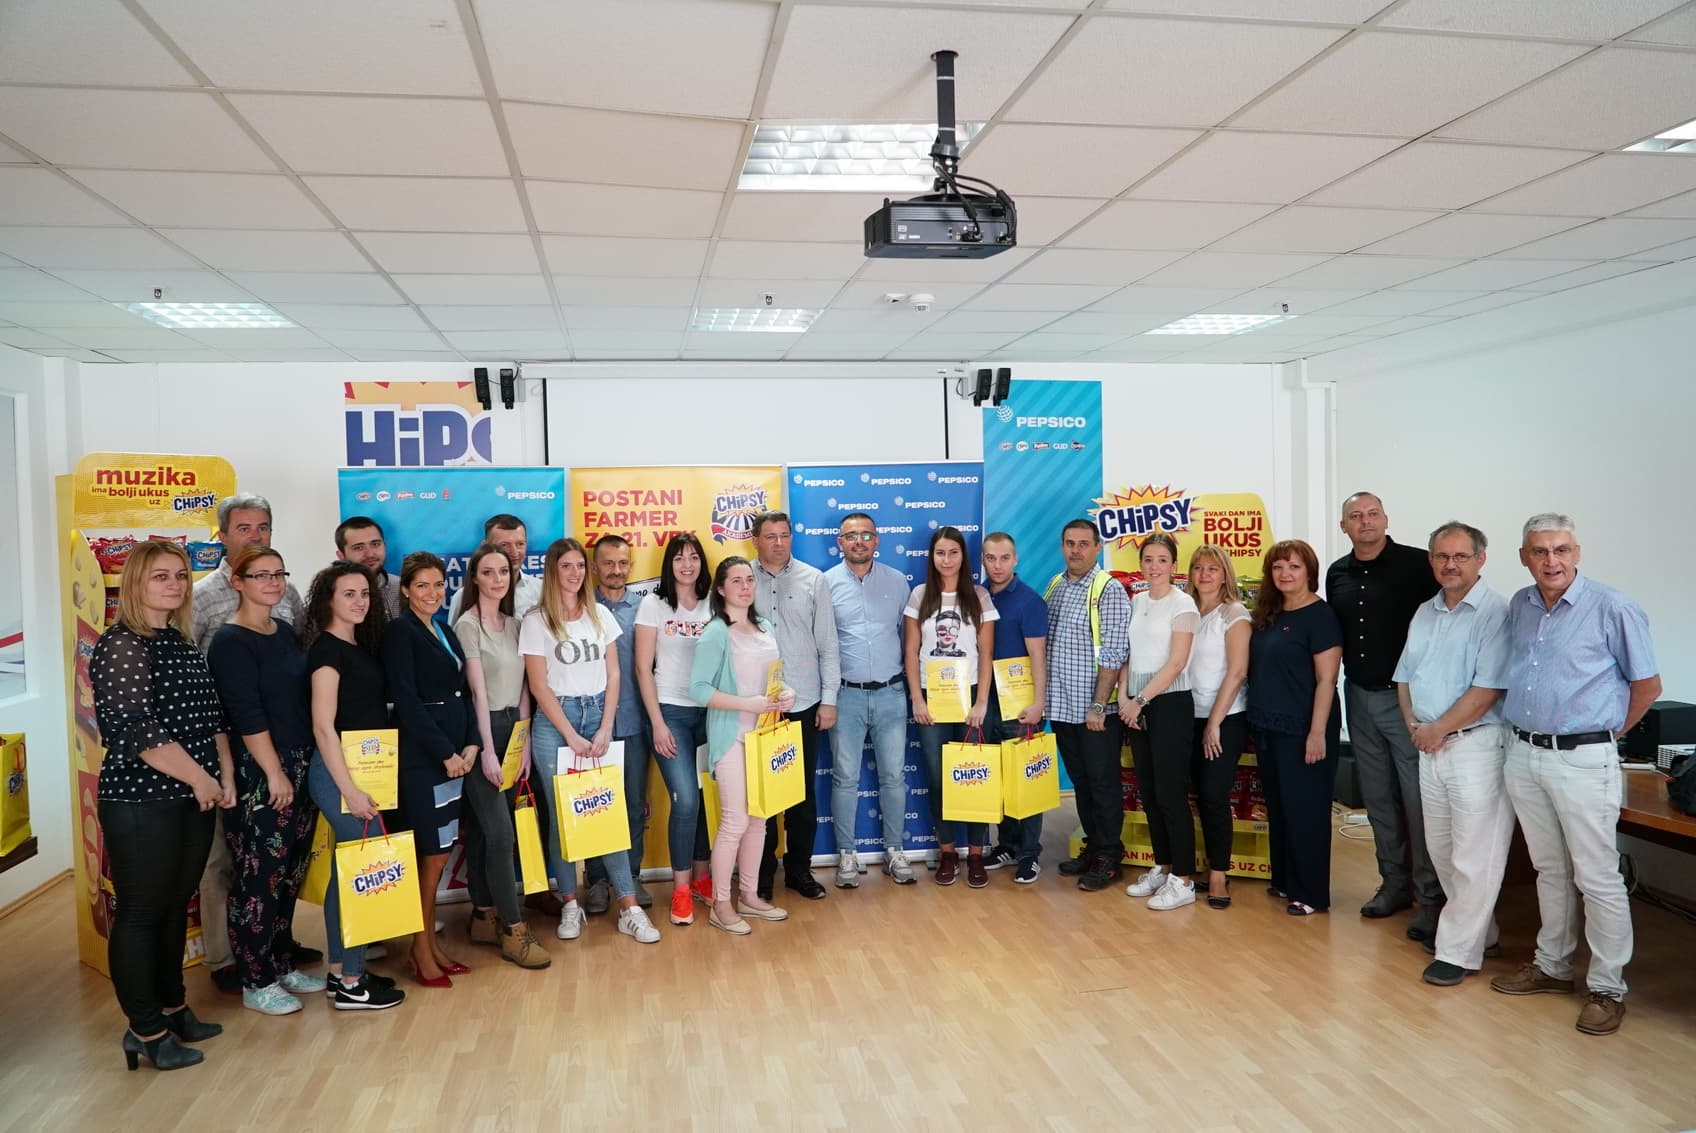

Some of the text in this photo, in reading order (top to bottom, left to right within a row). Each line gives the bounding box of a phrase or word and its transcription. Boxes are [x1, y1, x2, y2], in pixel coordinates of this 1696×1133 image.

[1016, 416, 1086, 428] PEPSICO
[96, 466, 196, 486] muzika
[938, 476, 979, 484] PEPSICO
[804, 479, 844, 487] PEPSICO
[109, 487, 136, 498] bolji
[139, 488, 169, 497] ukus
[507, 492, 555, 500] PEPSICO
[583, 490, 683, 507] POSTANI
[905, 501, 946, 509] PEPSICO
[584, 510, 678, 528] FARMER
[1204, 517, 1262, 531] BOLJI
[805, 527, 840, 535] PEPSIC
[1204, 533, 1262, 547] UKUS
[1227, 549, 1262, 557] HIPSY
[554, 638, 600, 665] Oh
[1238, 861, 1256, 871] UZ
